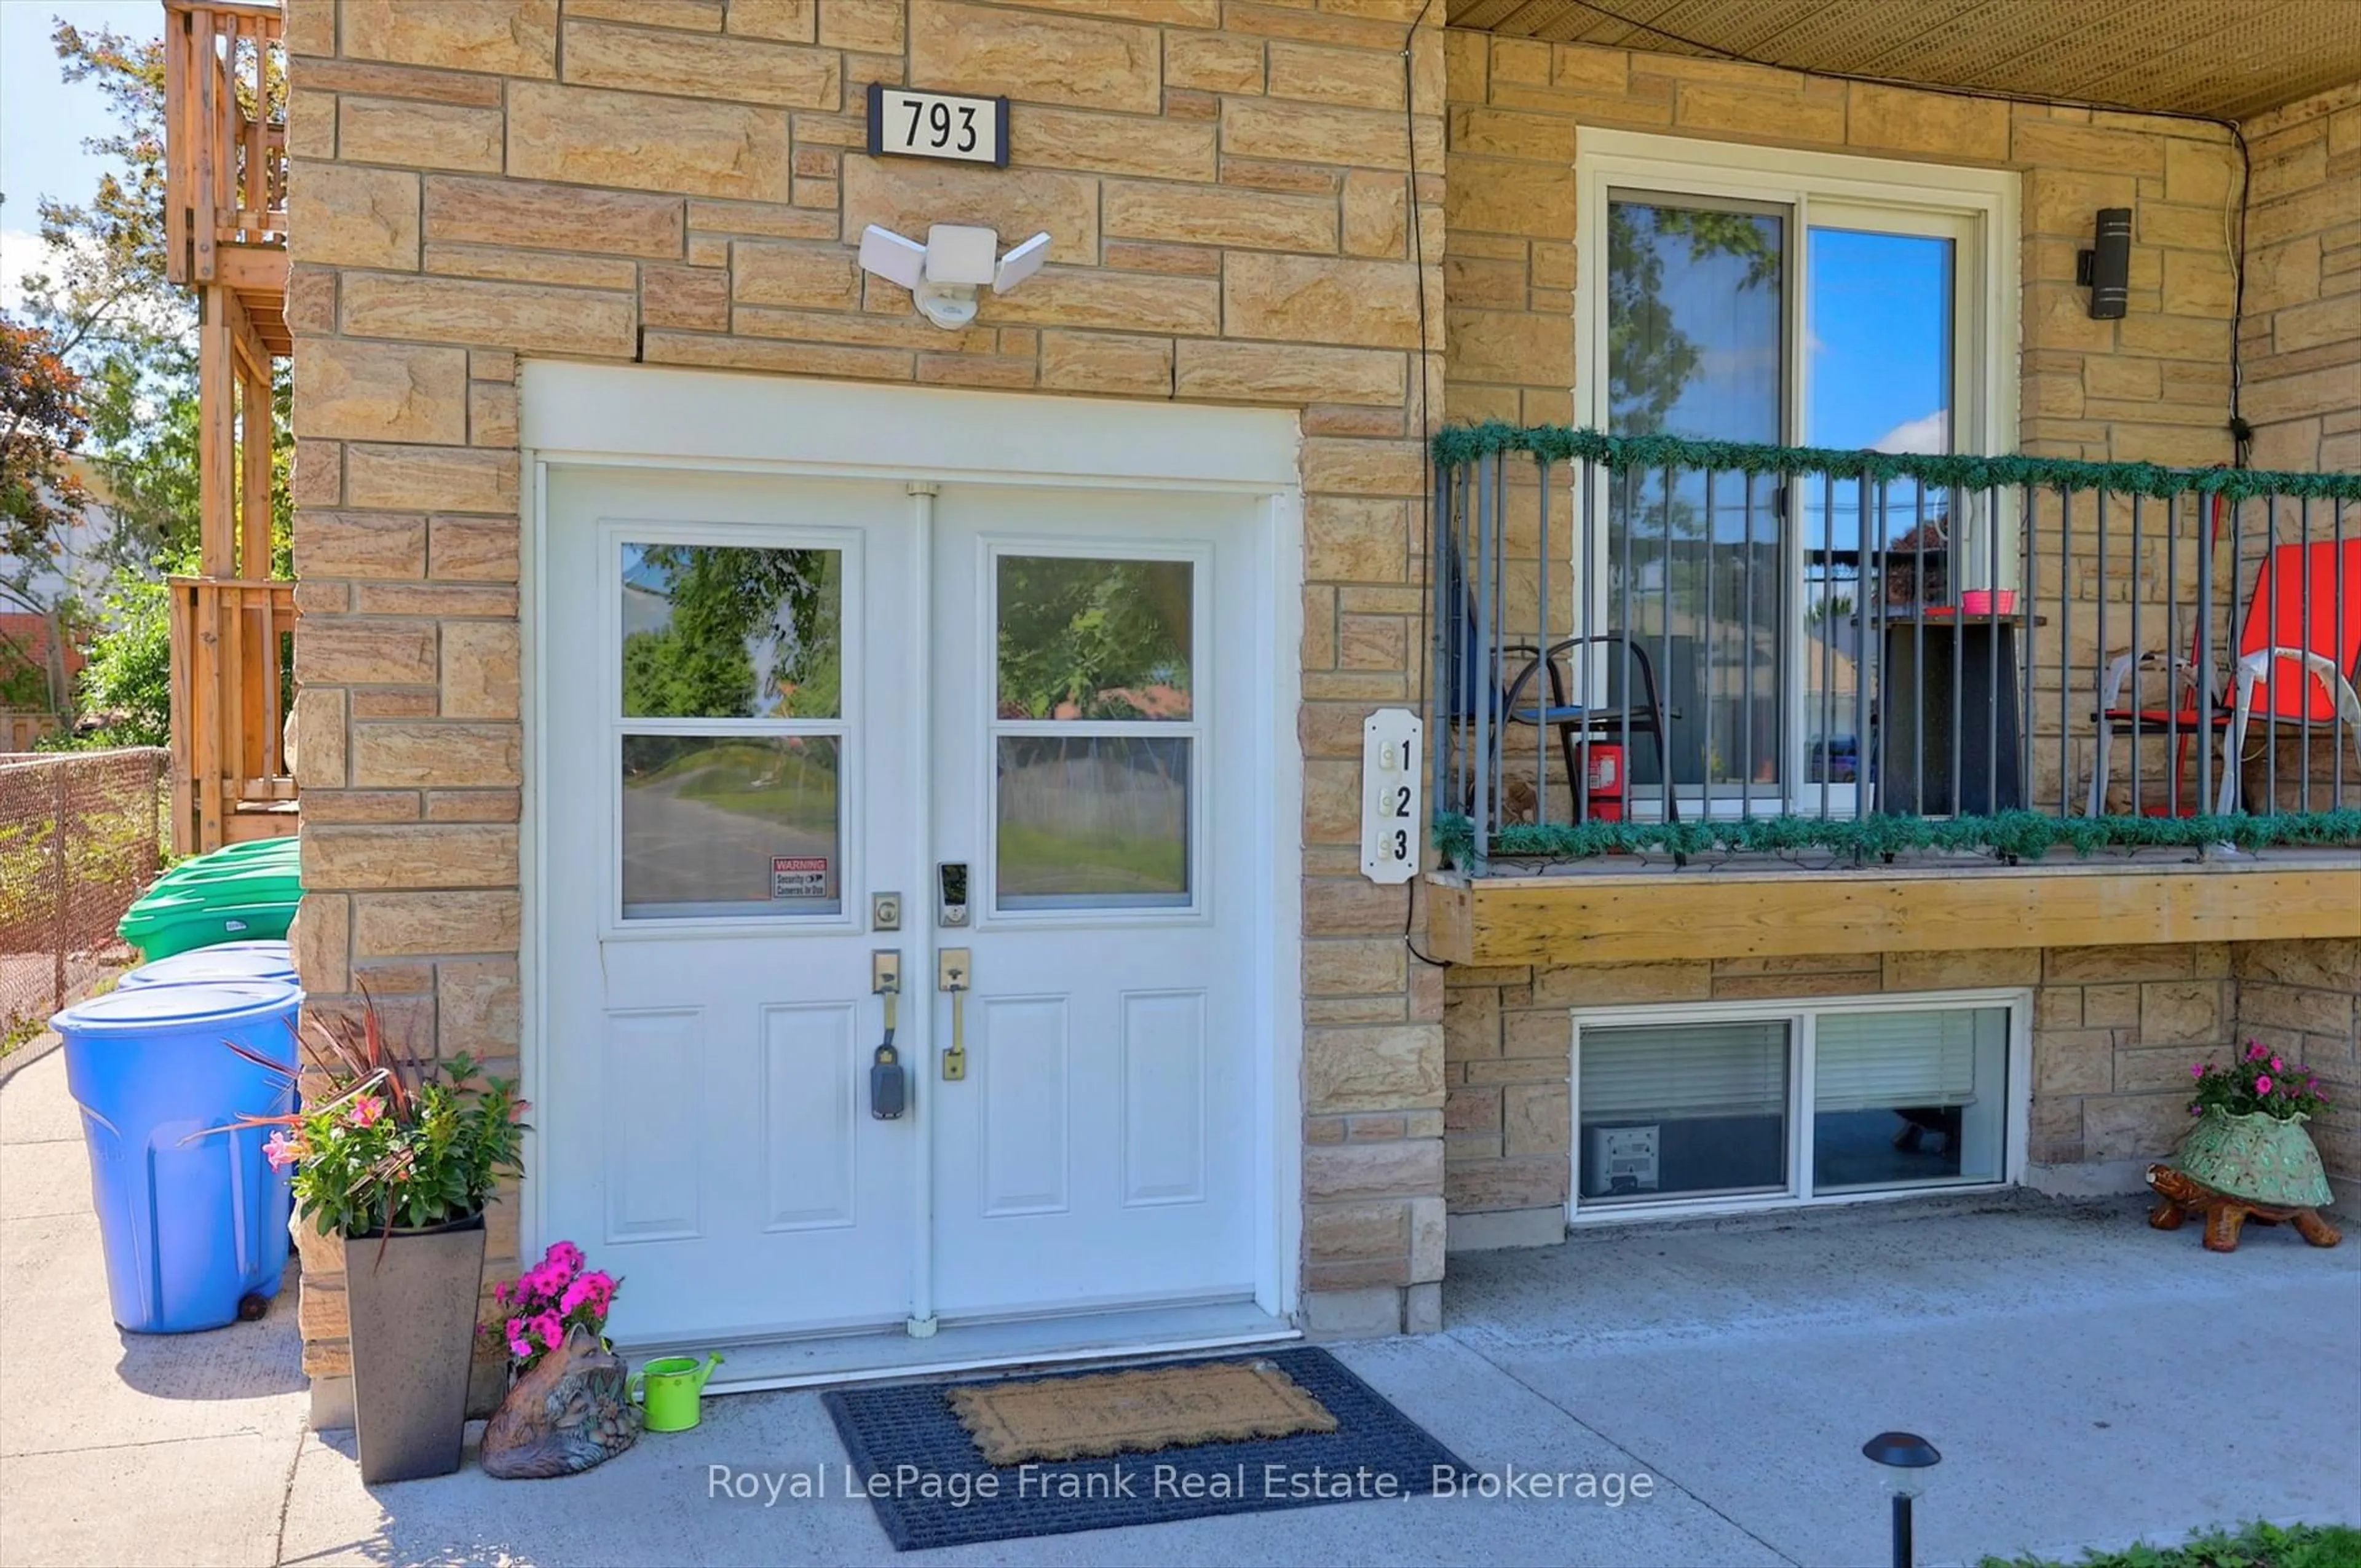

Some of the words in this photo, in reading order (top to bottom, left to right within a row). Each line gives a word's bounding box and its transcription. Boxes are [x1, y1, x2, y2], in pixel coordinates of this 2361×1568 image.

[903, 100, 976, 152] 793
[1402, 740, 1410, 770] 1
[1396, 786, 1411, 817] 2
[1394, 830, 1407, 860] 3
[776, 860, 825, 869] WARNING
[777, 874, 804, 885] Security
